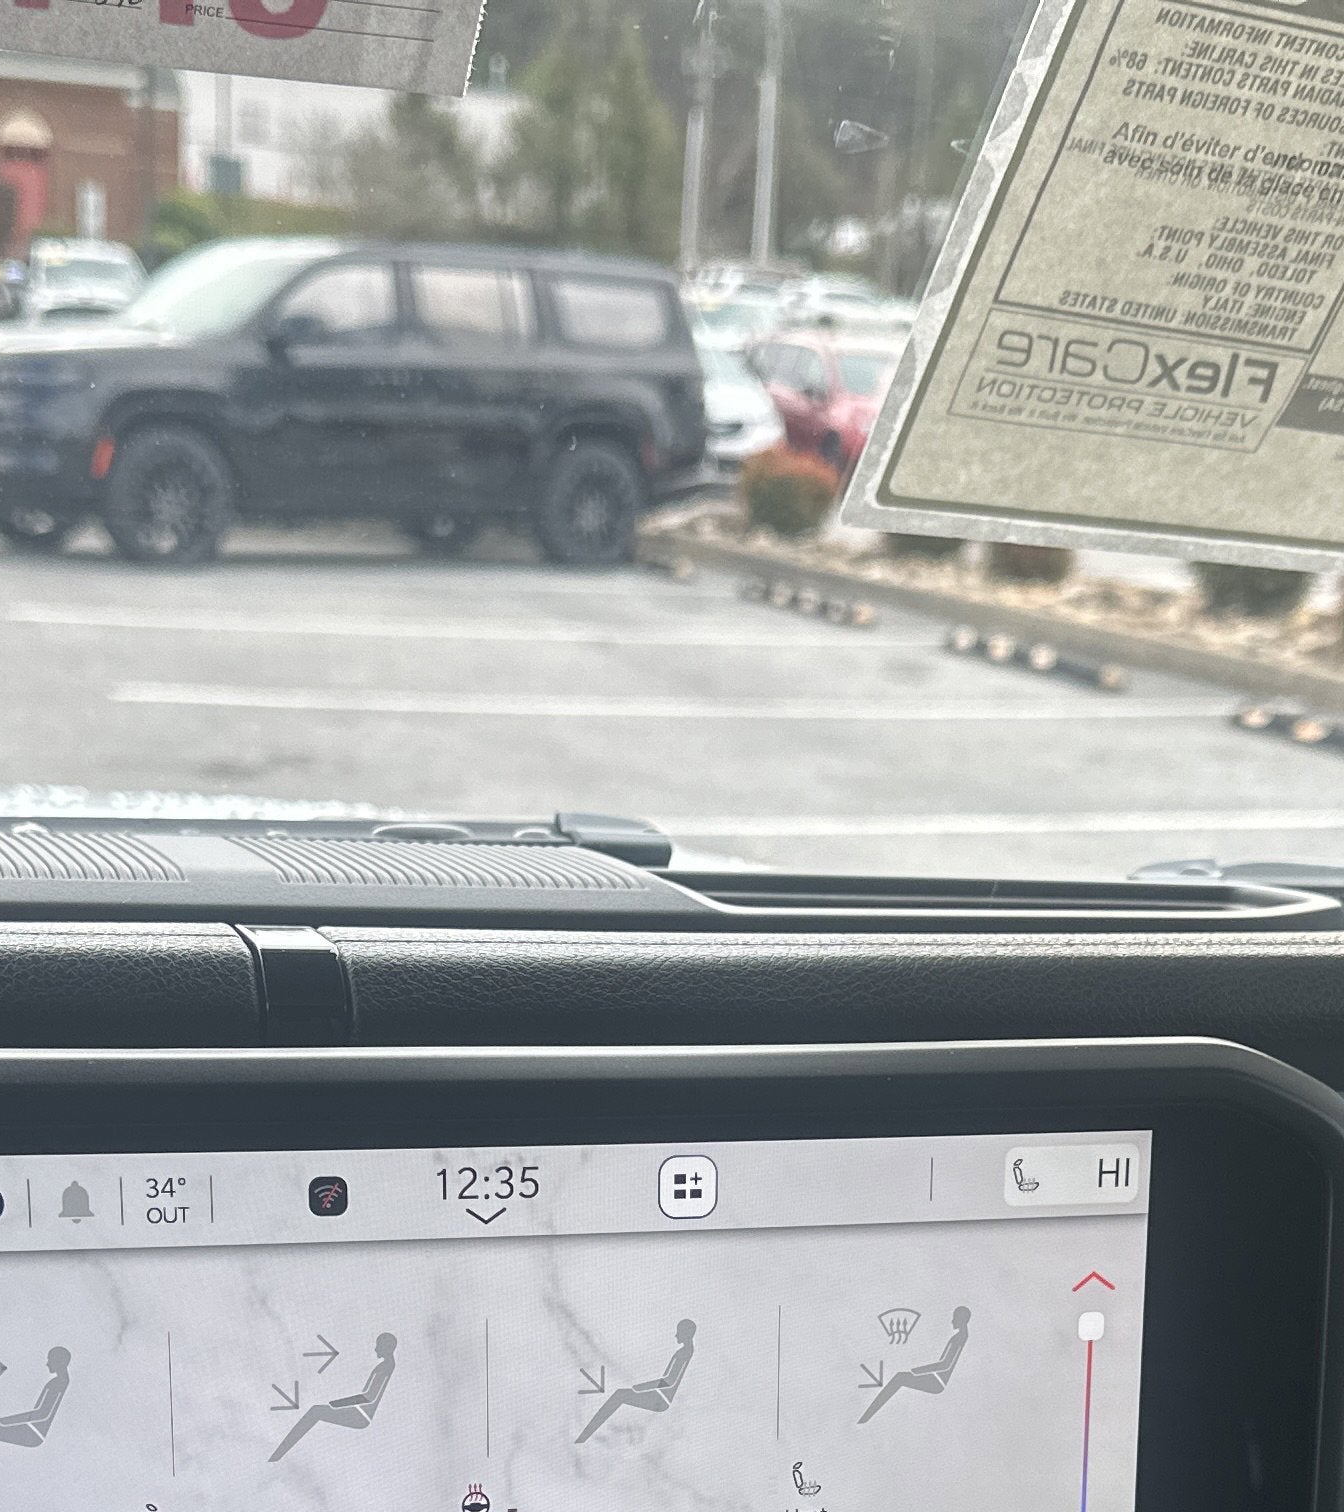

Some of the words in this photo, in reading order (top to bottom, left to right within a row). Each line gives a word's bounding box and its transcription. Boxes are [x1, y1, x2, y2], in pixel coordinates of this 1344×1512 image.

[185, 4, 224, 18] PRICE
[1098, 1158, 1130, 1187] HI
[145, 1177, 187, 1198] 34°
[436, 1167, 540, 1200] 12:35
[146, 1207, 189, 1224] OUT
